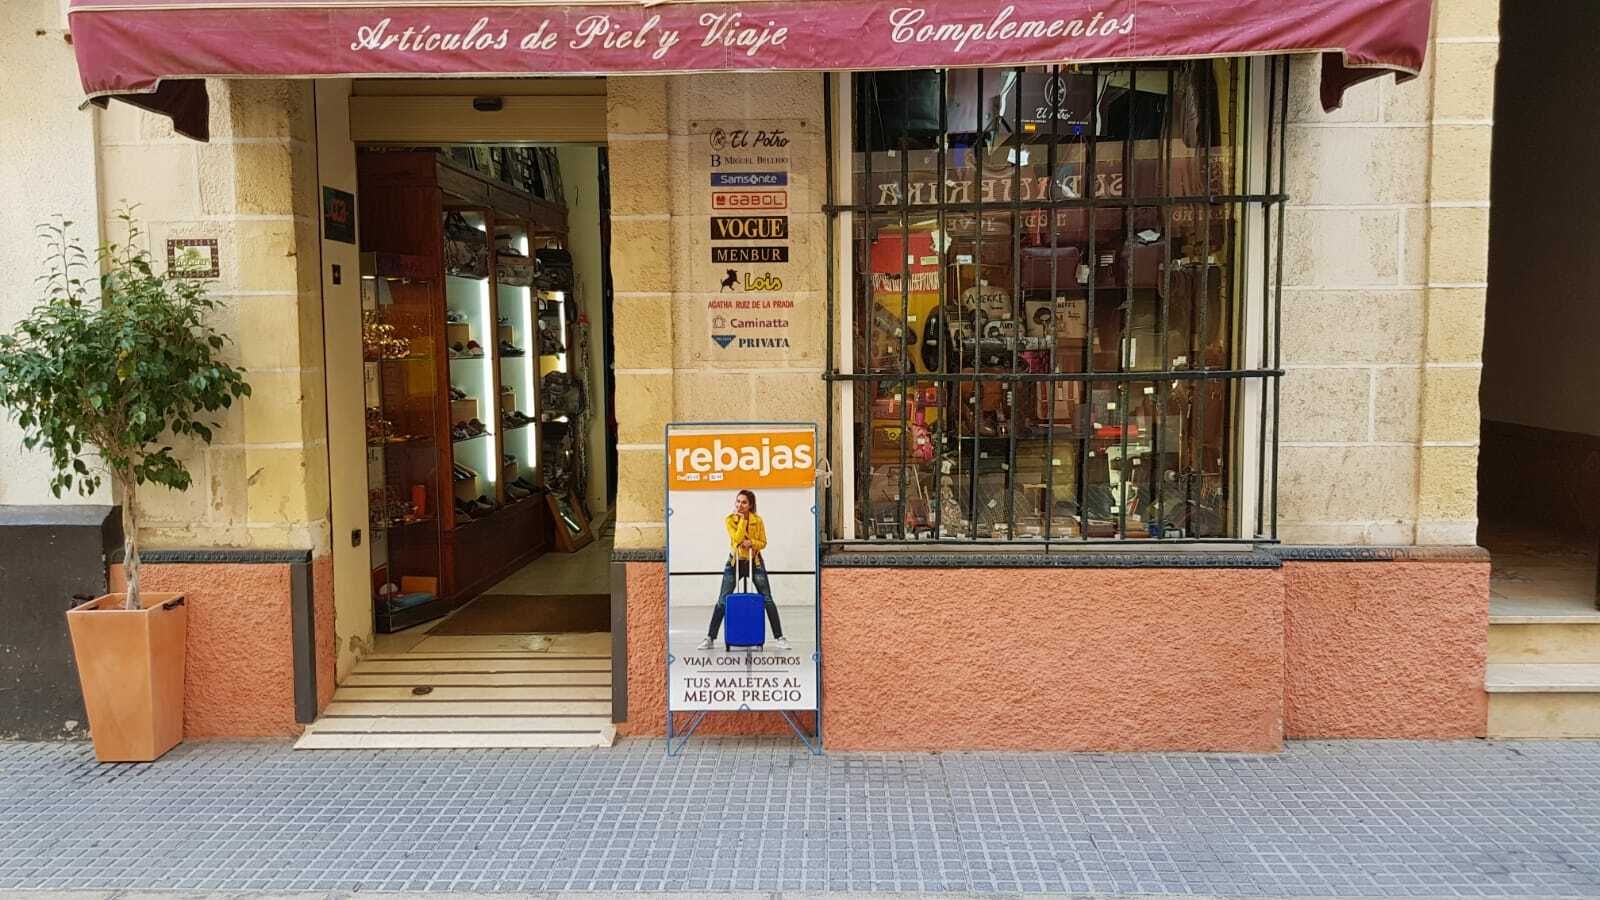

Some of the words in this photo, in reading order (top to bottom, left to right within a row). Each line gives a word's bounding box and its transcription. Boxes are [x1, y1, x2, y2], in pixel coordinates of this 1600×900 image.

[351, 17, 508, 51] Artículos
[520, 20, 558, 51] de
[569, 14, 658, 51] Piel
[651, 26, 680, 59] y
[698, 12, 789, 57] Viaje
[889, 6, 1136, 52] Complementos
[729, 130, 749, 149] El
[752, 129, 790, 149] Potro
[711, 154, 721, 167] B
[720, 174, 777, 185] Samsonite
[716, 218, 784, 238] VOGUE
[717, 249, 781, 261] MENBUR
[744, 272, 783, 291] Lois
[708, 300, 733, 310] AGATHA
[735, 300, 750, 309] RUIZ
[751, 300, 761, 309] DE
[762, 300, 771, 309] LA
[772, 300, 794, 309] PRADA
[730, 318, 789, 329] Caminatta
[738, 338, 790, 349] PRIVATA
[675, 438, 813, 477] rebajas
[683, 656, 713, 668] VIAJA
[716, 656, 741, 666] CON
[745, 656, 801, 666] NOSOTROS
[684, 677, 711, 689] TUS
[715, 677, 779, 689] MALETAS
[783, 677, 801, 688] AL
[684, 690, 736, 704] MEJOR
[742, 689, 802, 702] PRECIO
